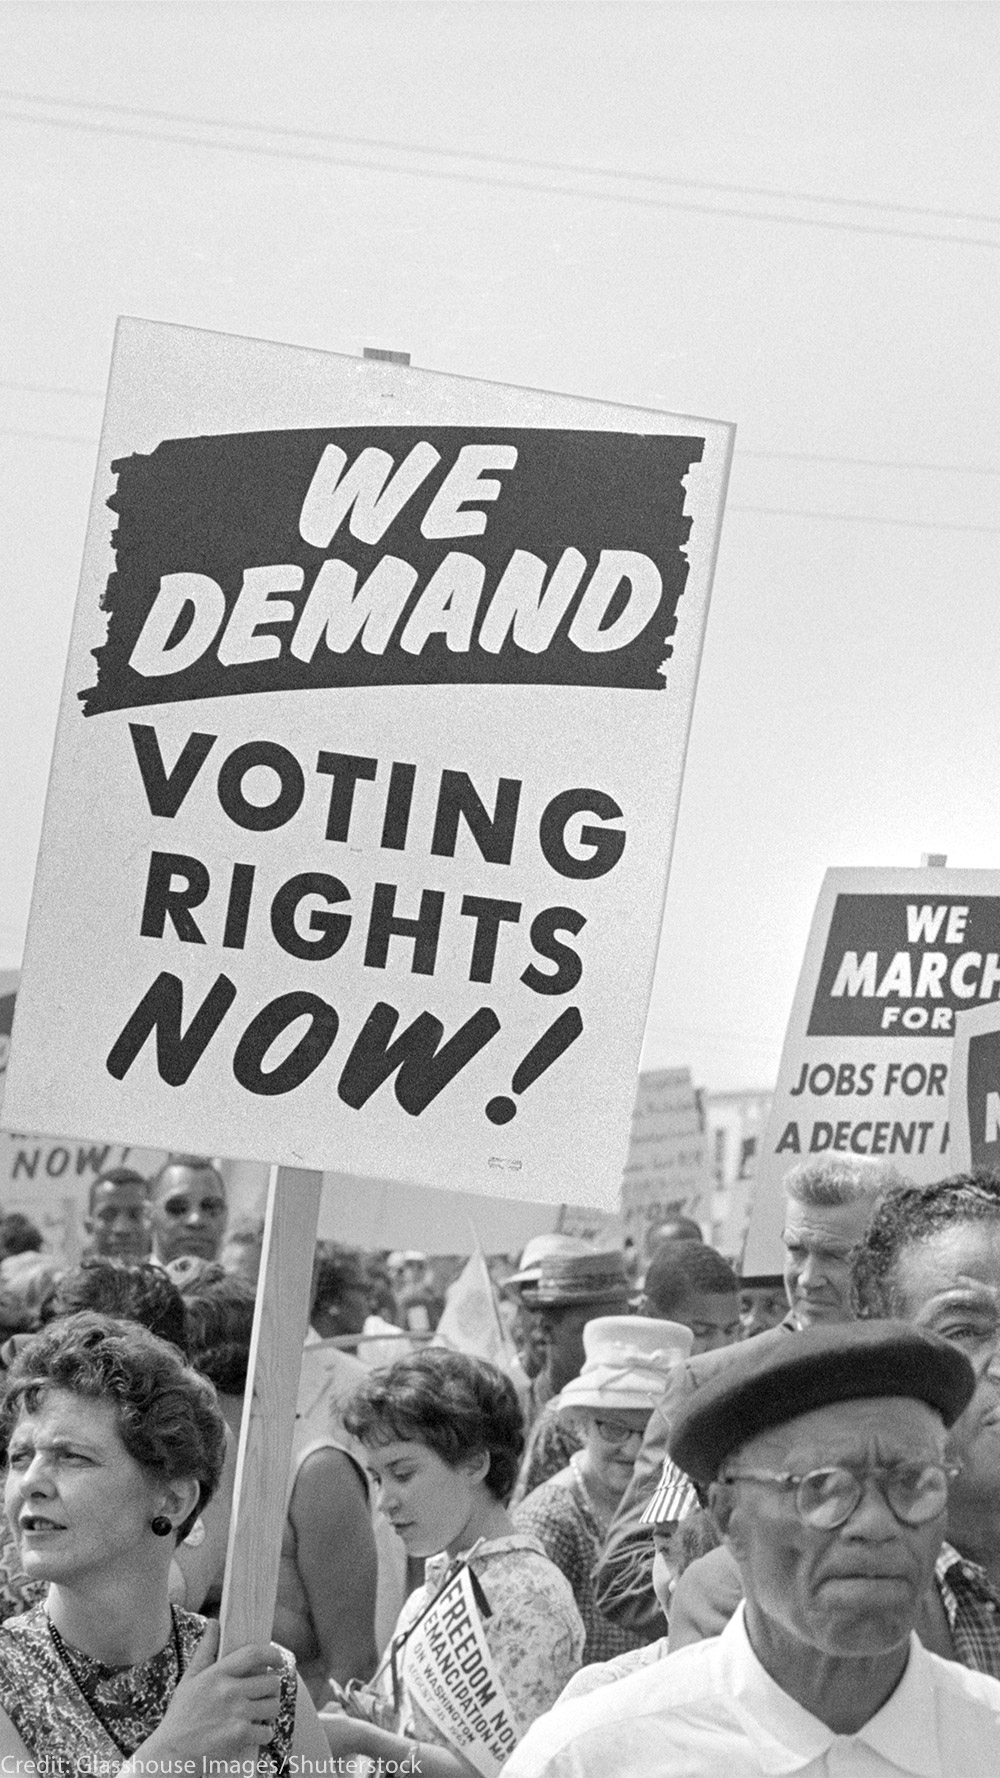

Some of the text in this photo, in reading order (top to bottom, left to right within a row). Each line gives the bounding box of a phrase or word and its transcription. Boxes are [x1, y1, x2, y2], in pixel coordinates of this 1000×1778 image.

[299, 440, 518, 548] WE
[128, 547, 663, 678] DEMAND
[128, 722, 627, 880] VOTING
[139, 851, 588, 996] RIGHTS
[830, 951, 1000, 999] MARCH
[906, 905, 969, 944] WE
[106, 971, 584, 1126] NOW!
[881, 1006, 953, 1030] FOR
[790, 1063, 948, 1097] JOBS FOR
[775, 1122, 801, 1154] A
[809, 1121, 934, 1154] DECENT
[423, 1611, 494, 1743] EMANCIPATION
[439, 1579, 497, 1708] FREEDOM
[423, 1663, 475, 1742] WASHINGTON
